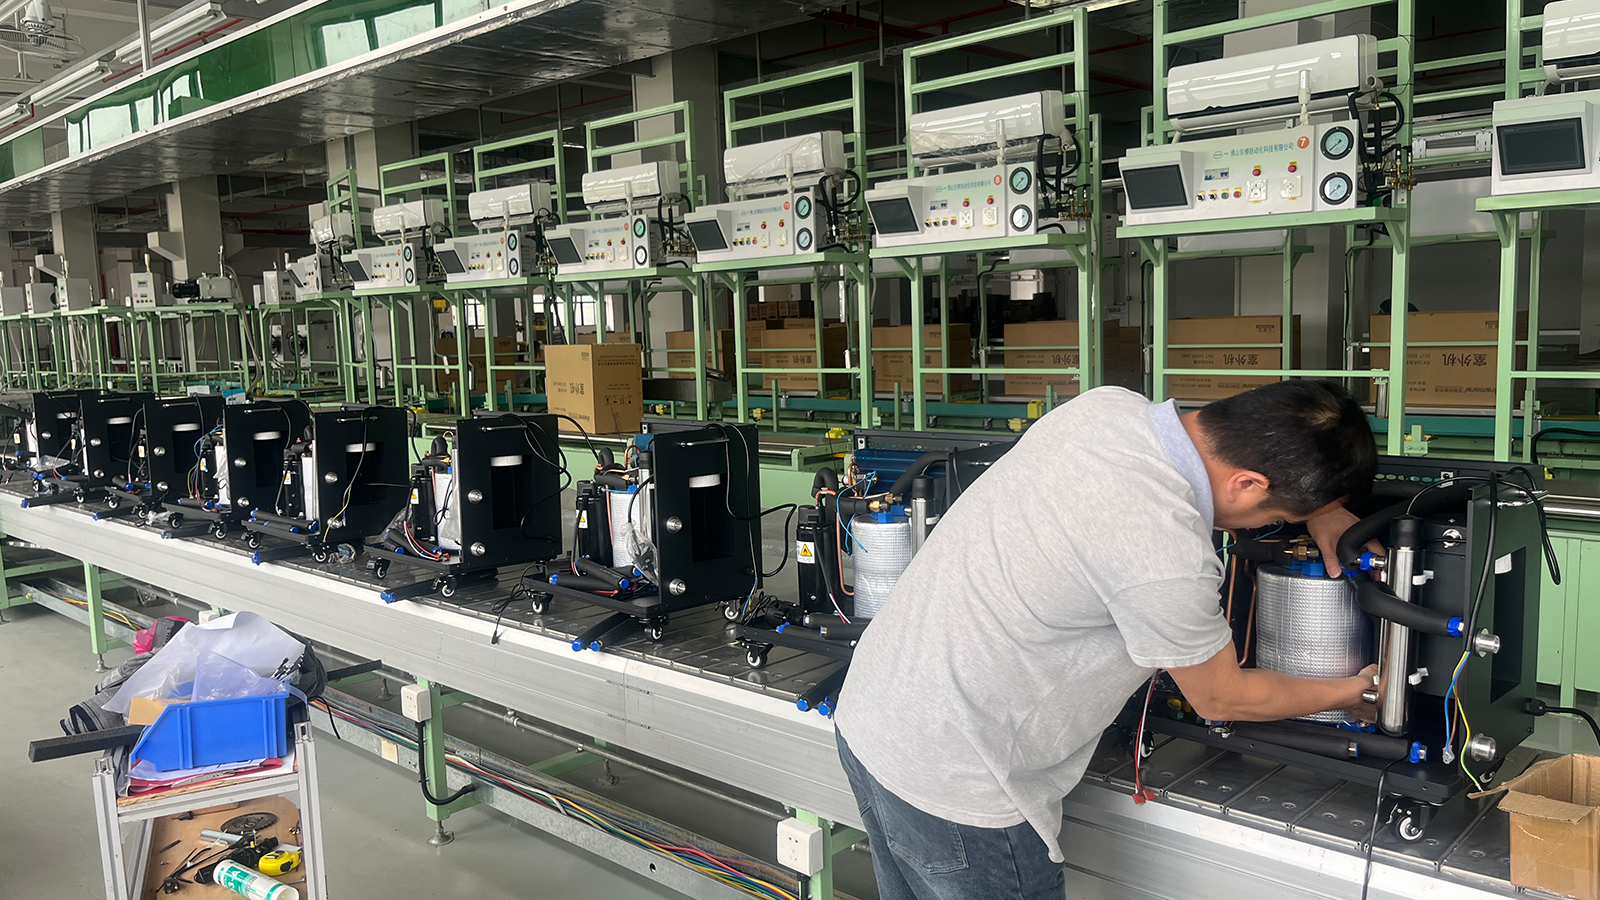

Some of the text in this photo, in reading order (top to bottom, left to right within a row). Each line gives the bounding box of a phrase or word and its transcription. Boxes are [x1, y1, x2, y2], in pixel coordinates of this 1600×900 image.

[1300, 138, 1306, 147] 7
[1223, 354, 1258, 365] 室外机
[1442, 353, 1487, 366] 室外机
